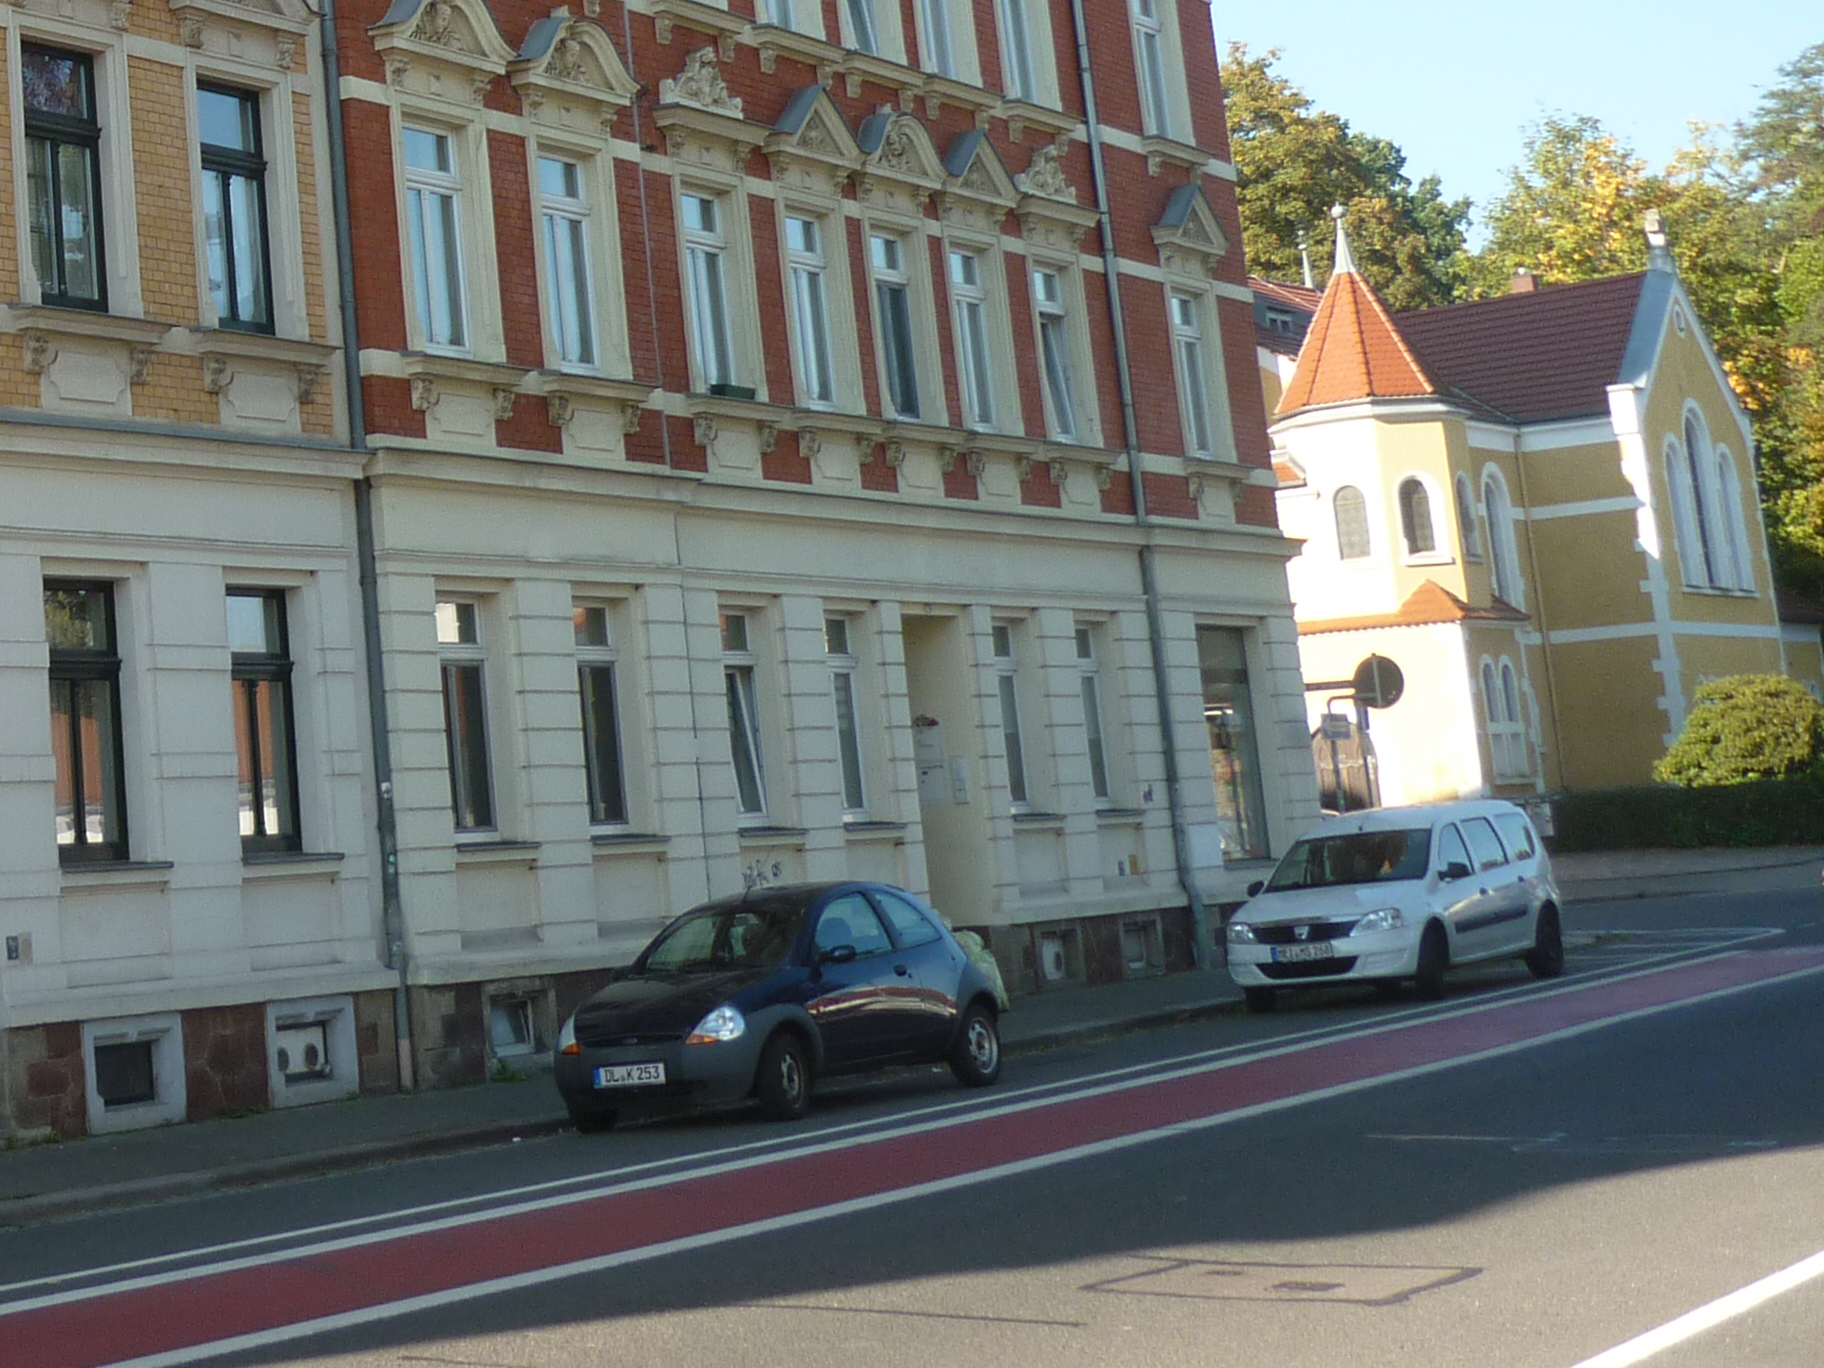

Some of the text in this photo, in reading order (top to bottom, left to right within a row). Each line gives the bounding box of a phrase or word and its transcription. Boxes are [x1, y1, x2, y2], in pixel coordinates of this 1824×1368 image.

[604, 1065, 660, 1083] DL K 253
